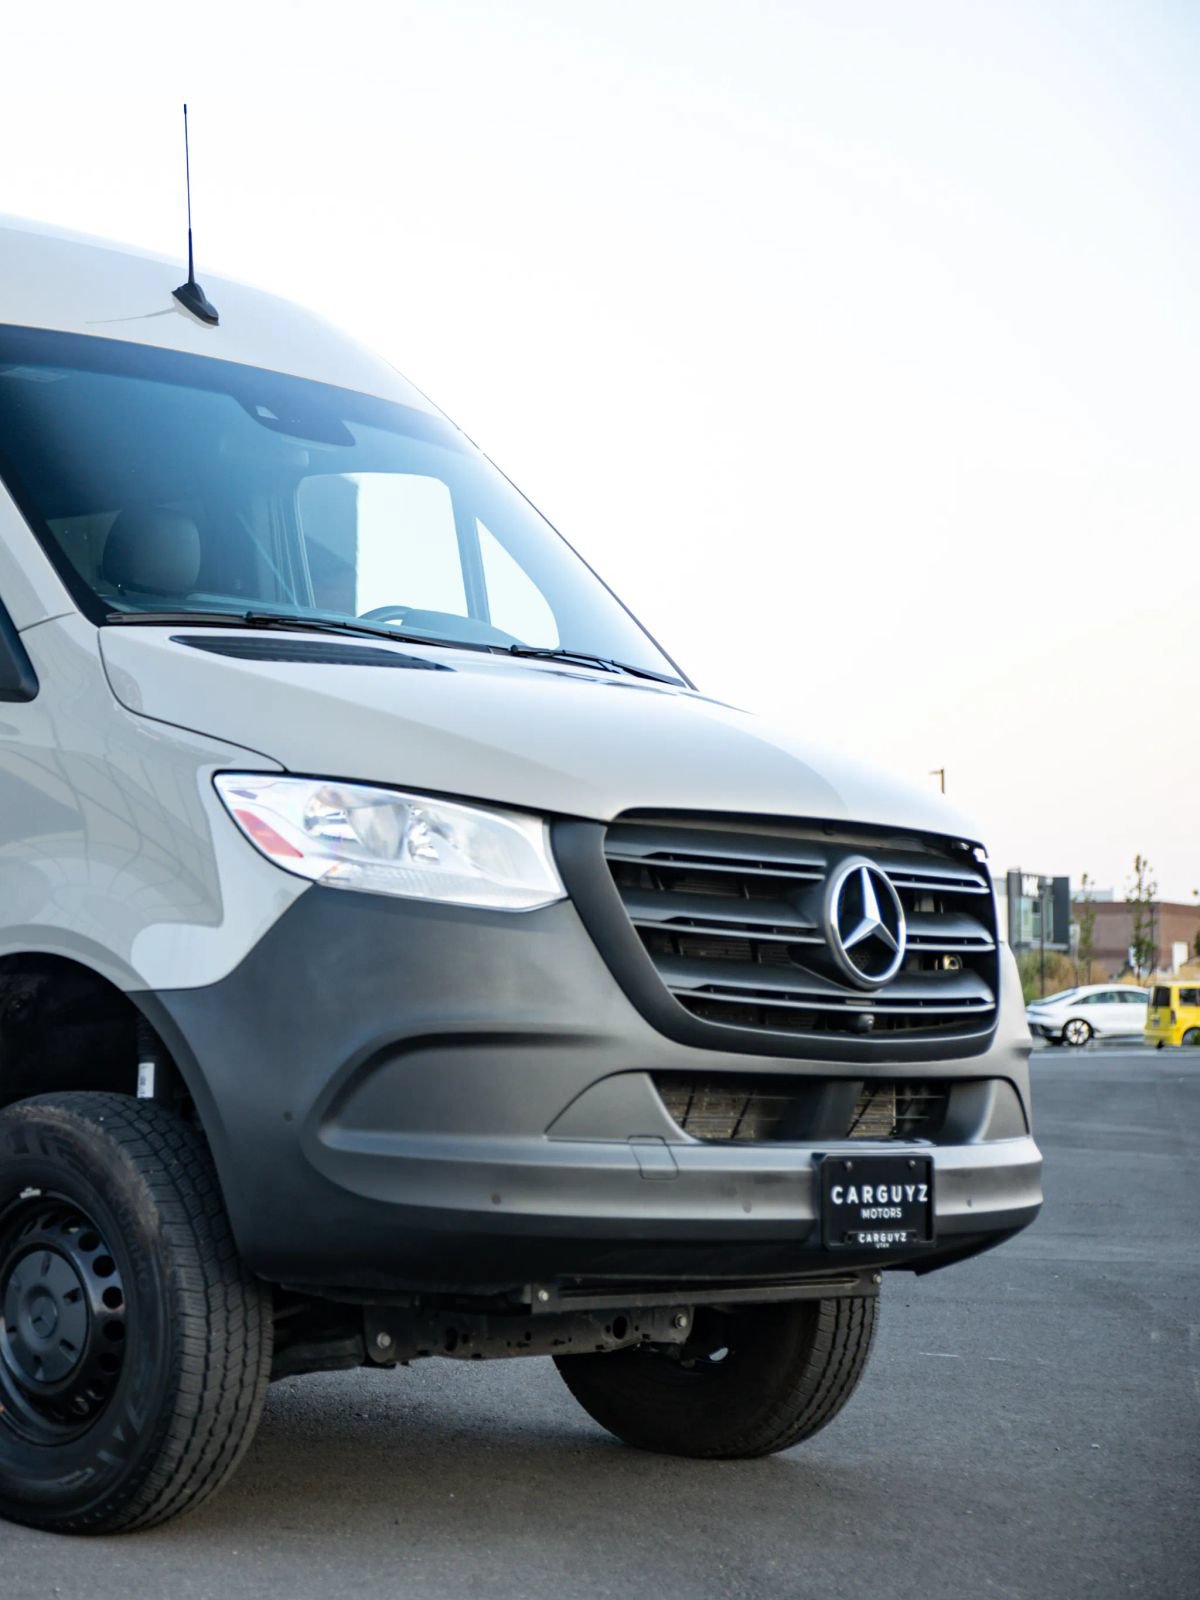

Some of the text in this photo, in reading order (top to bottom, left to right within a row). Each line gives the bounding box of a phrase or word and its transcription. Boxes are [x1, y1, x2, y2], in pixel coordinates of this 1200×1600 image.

[831, 1184, 928, 1204] CARGUYZ
[861, 1207, 902, 1219] MOTORS
[858, 1232, 907, 1243] CARGUYZ
